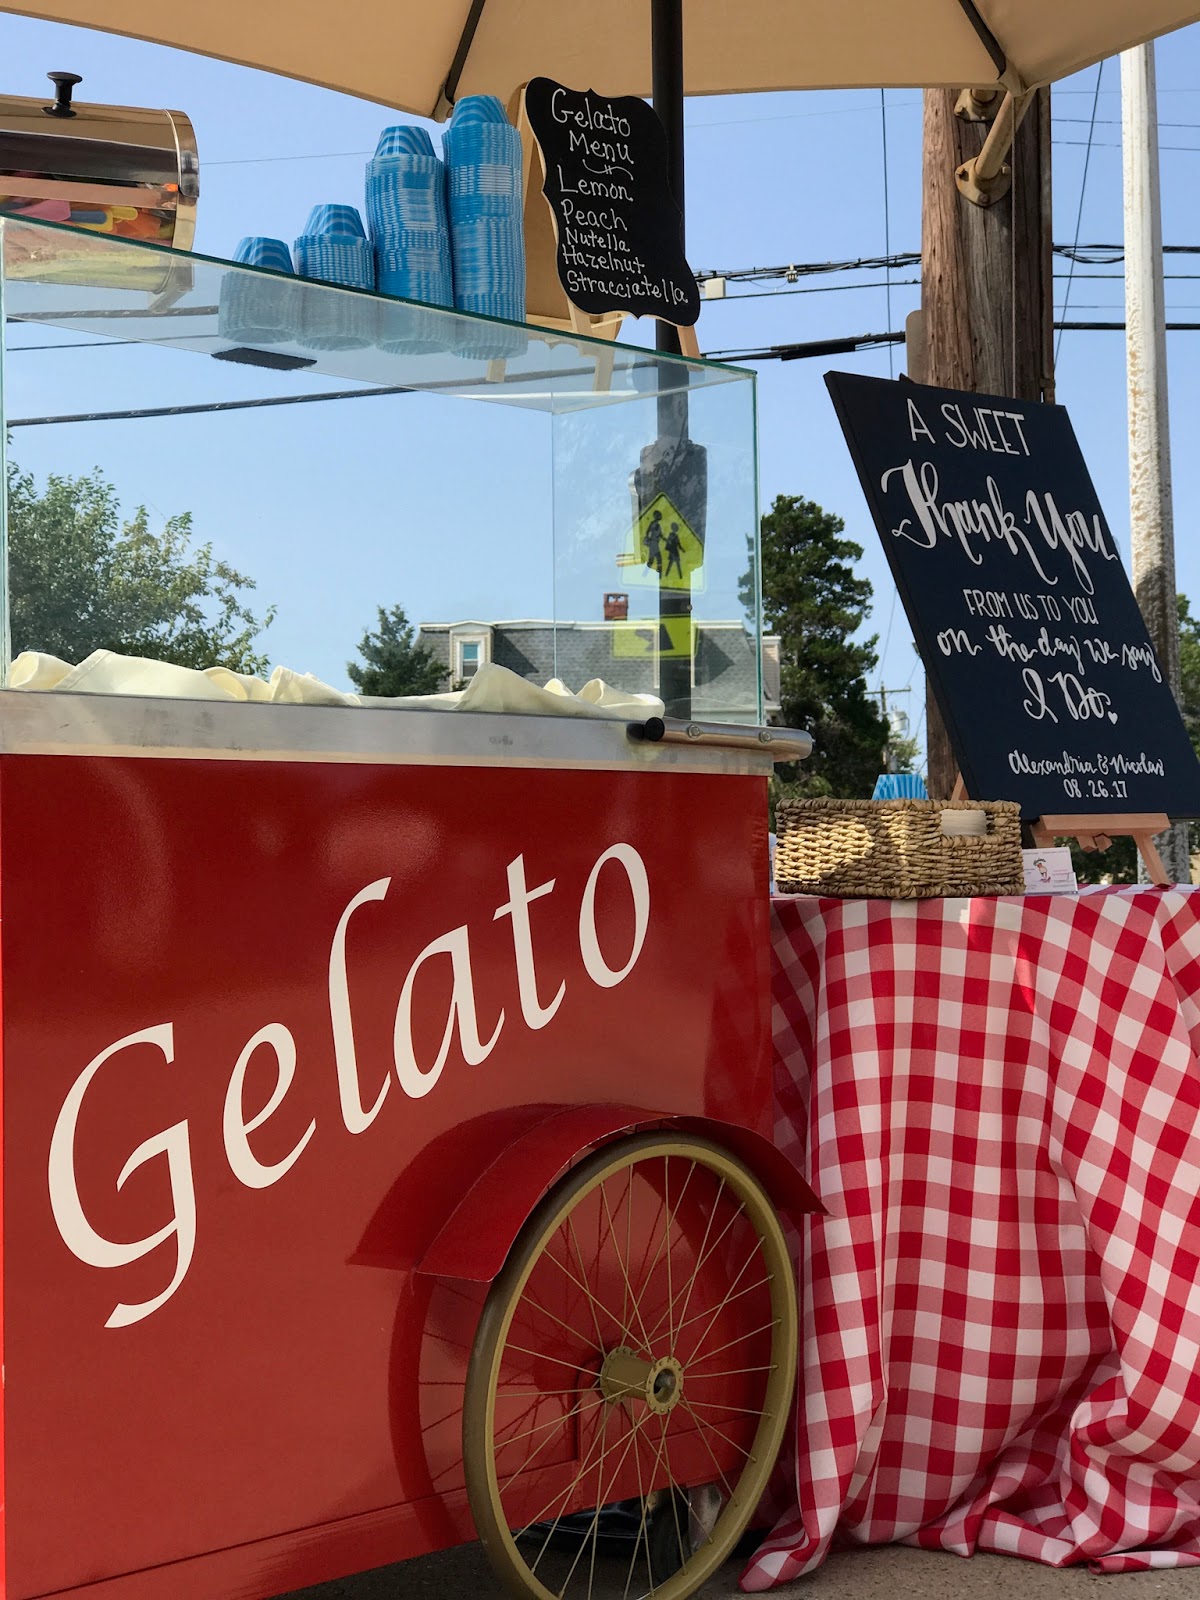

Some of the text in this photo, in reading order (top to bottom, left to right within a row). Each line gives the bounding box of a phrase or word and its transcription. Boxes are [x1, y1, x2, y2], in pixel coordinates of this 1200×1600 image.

[551, 88, 631, 137] Gelato
[569, 130, 634, 164] Menu
[557, 164, 634, 201] Lemon
[561, 199, 628, 231] Peach
[565, 227, 630, 252] Nutella
[562, 243, 645, 274] Hazelnut
[567, 270, 688, 305] Stracciatella
[906, 397, 1030, 456] A SWEET
[880, 458, 1118, 595] Thank You
[963, 589, 1099, 625] FROM US TO YOU
[937, 628, 982, 656] on
[985, 624, 1037, 662] the
[1037, 627, 1085, 675] day
[1122, 642, 1162, 683] say
[1022, 668, 1058, 723] I
[1096, 753, 1109, 776] &
[1109, 752, 1165, 777] Nicolas
[1063, 779, 1128, 798] 08.26.17
[48, 842, 650, 1328] Gelato
